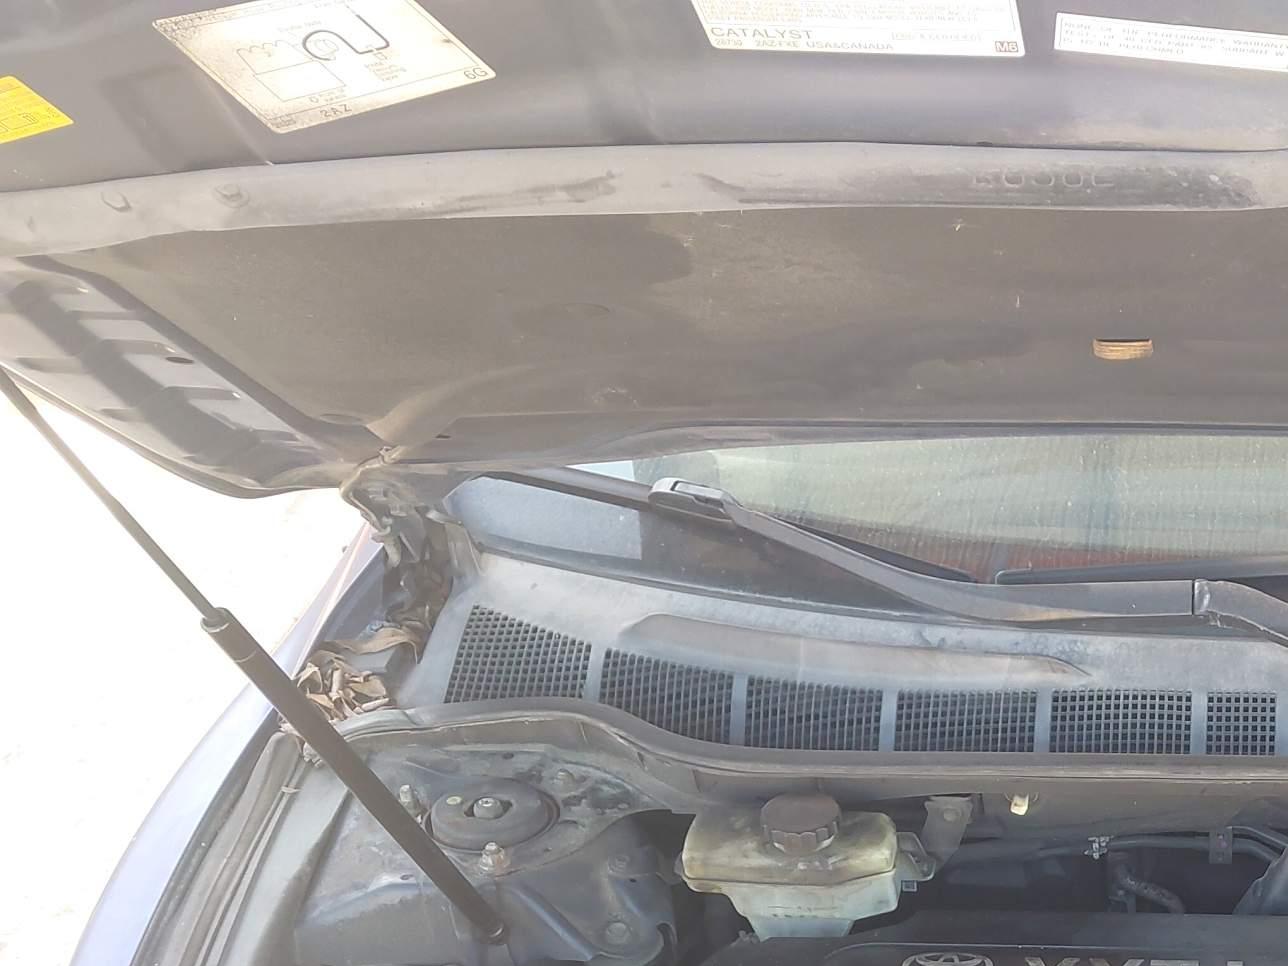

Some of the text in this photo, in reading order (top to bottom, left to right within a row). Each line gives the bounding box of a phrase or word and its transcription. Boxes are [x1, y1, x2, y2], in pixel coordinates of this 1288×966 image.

[710, 27, 813, 40] CATALYST
[995, 41, 1019, 52] M6
[463, 66, 489, 80] 6G
